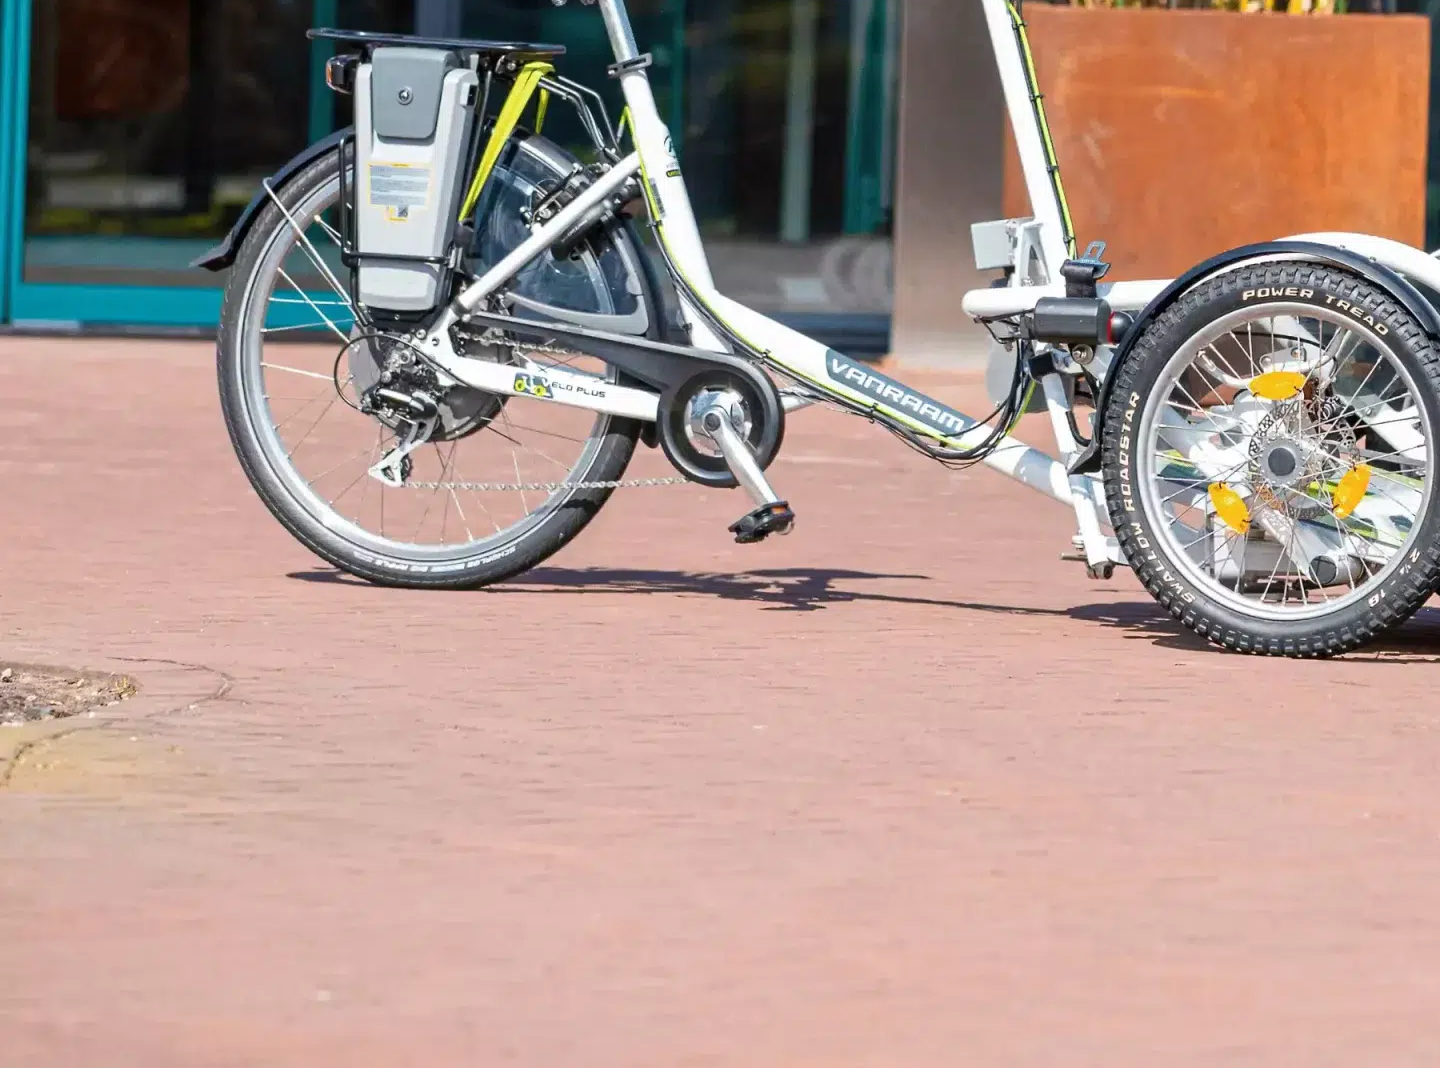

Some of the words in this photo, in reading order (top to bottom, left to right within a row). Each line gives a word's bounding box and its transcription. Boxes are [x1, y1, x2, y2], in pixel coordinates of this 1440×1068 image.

[1242, 287, 1315, 301] POWER
[1325, 294, 1389, 336] TREAD
[576, 386, 606, 398] PLUS
[831, 357, 965, 432] VANRAAM
[1119, 391, 1141, 513] ROADSTAR
[1130, 521, 1197, 605] SWALLOW
